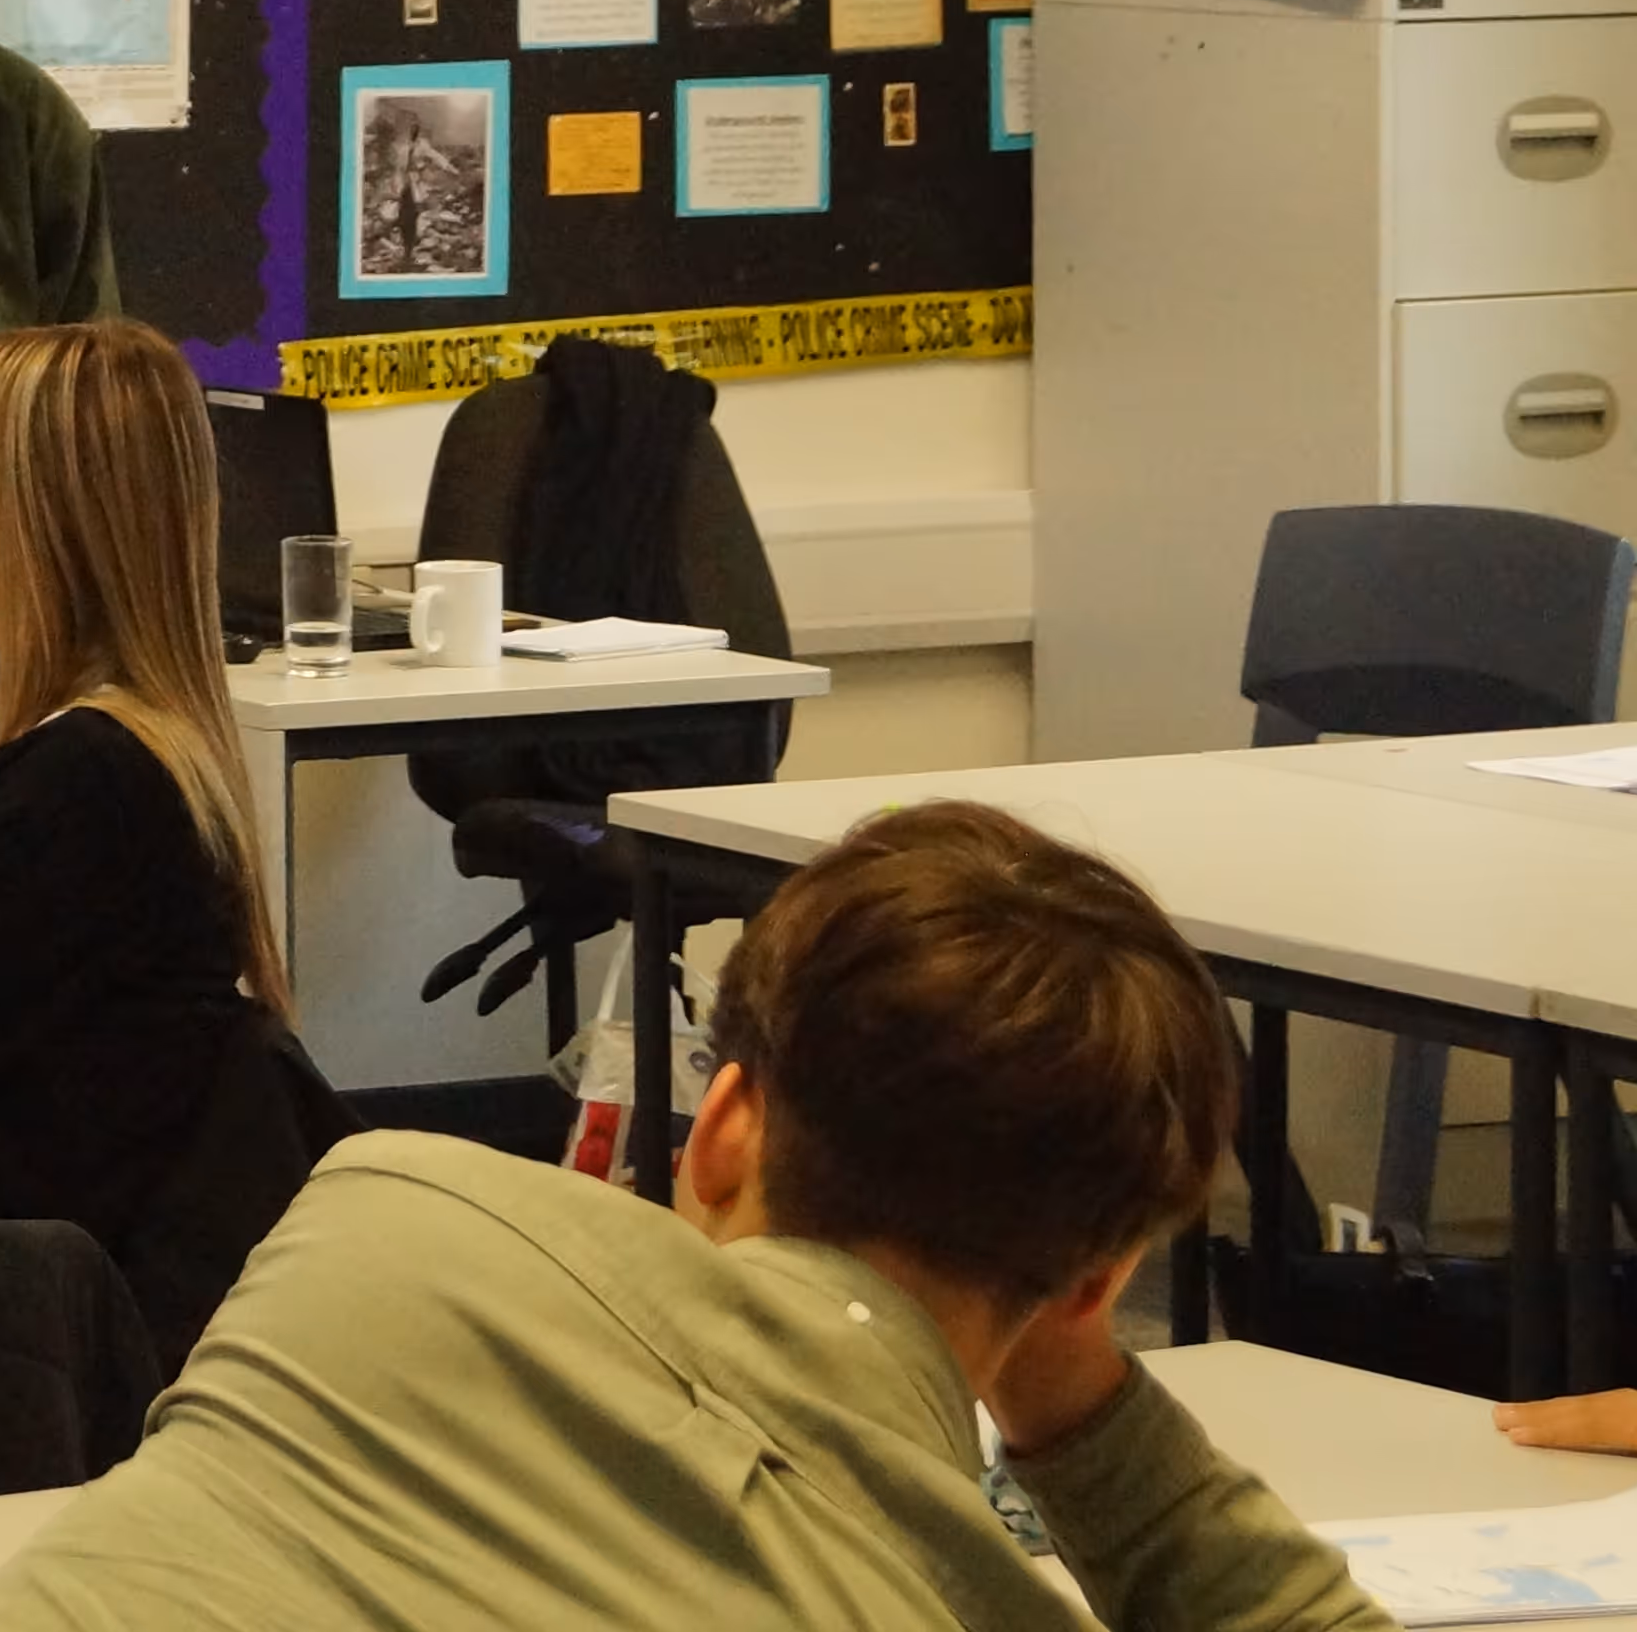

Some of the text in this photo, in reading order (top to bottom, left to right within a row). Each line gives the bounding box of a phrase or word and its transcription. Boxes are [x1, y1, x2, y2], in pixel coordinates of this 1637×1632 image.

[301, 342, 369, 400] POLICE
[376, 339, 437, 396] CRIME
[441, 333, 503, 391] SCENE
[780, 308, 847, 361] POLICE
[850, 304, 911, 356] CRIME
[913, 300, 973, 352] SCENE
